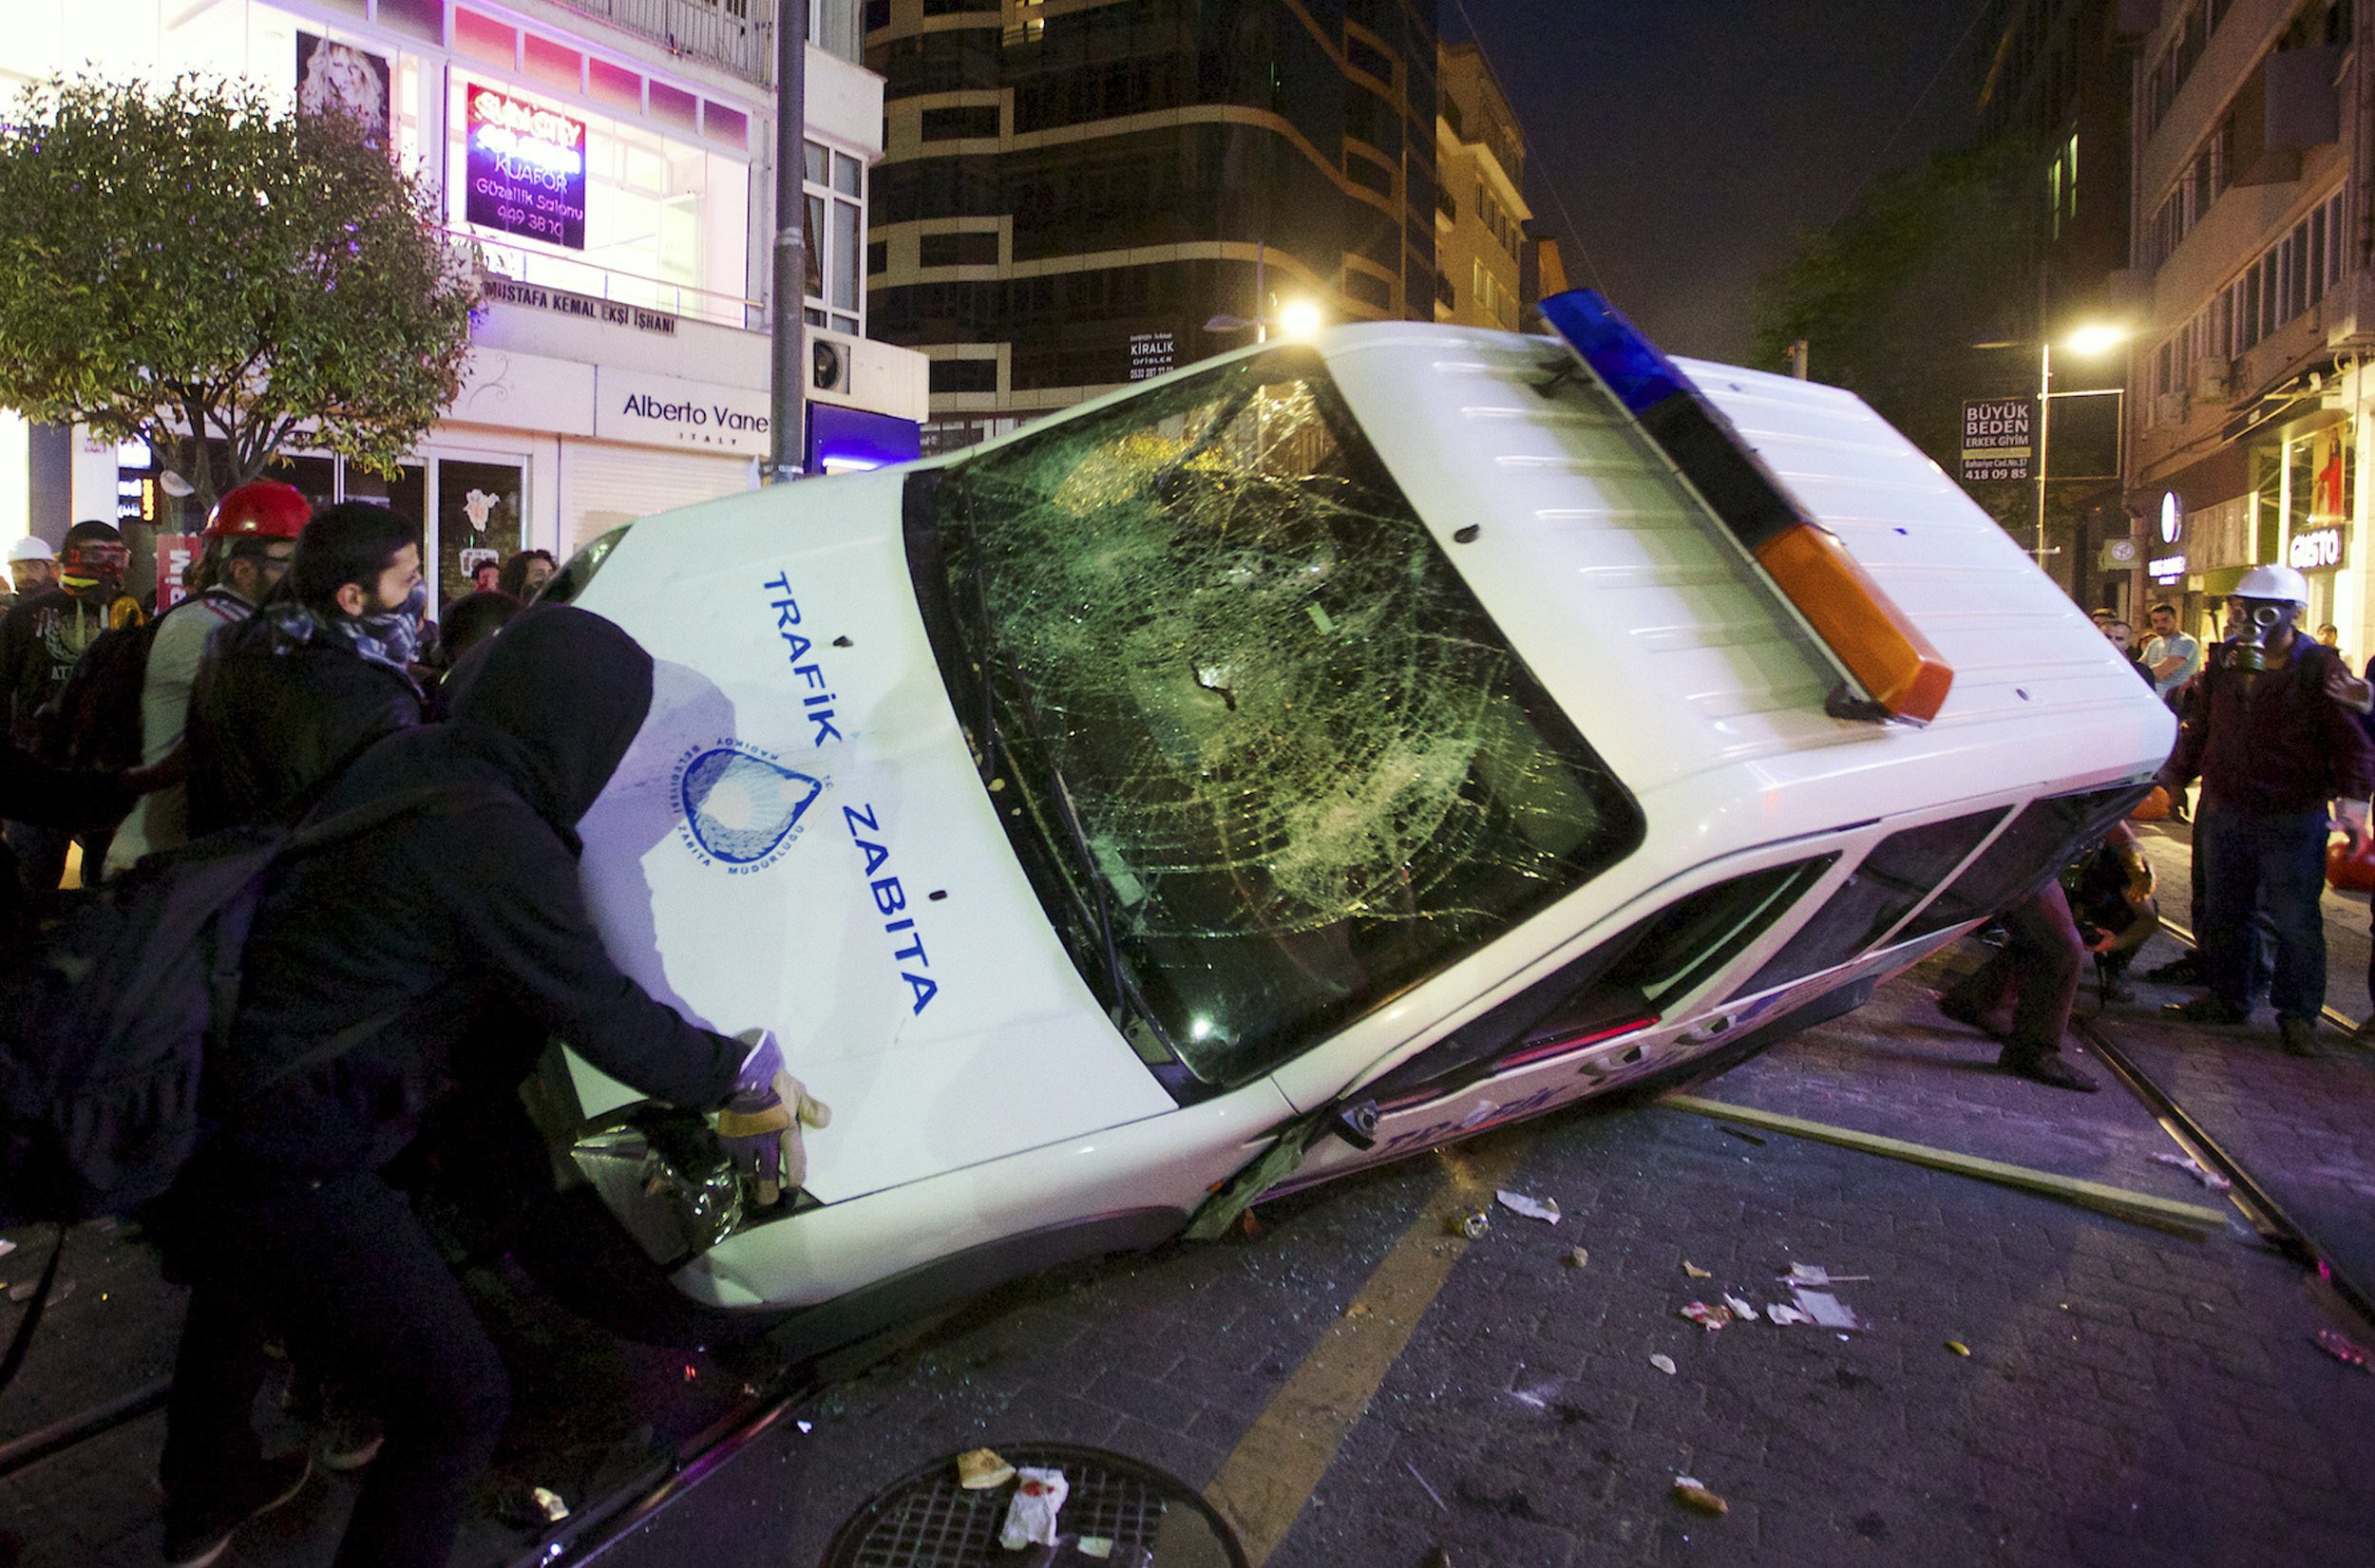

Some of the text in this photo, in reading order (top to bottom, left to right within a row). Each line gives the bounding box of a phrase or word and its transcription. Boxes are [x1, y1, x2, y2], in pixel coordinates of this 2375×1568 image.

[476, 178, 583, 221] Güzellik Salonu
[484, 280, 548, 309] MUSTAFA
[552, 293, 597, 318] KEMAL
[1130, 342, 1174, 355] KİRALIK
[623, 393, 771, 434] Alberto Vane
[1966, 403, 2029, 421] BÜYÜK
[1966, 419, 2029, 436] BEDEN
[679, 432, 736, 445] ITALY
[1966, 434, 2029, 448] ERKEK GİYİM
[1965, 468, 2027, 480] 418 09 85
[764, 571, 939, 1017] TRAFİK ZABITA
